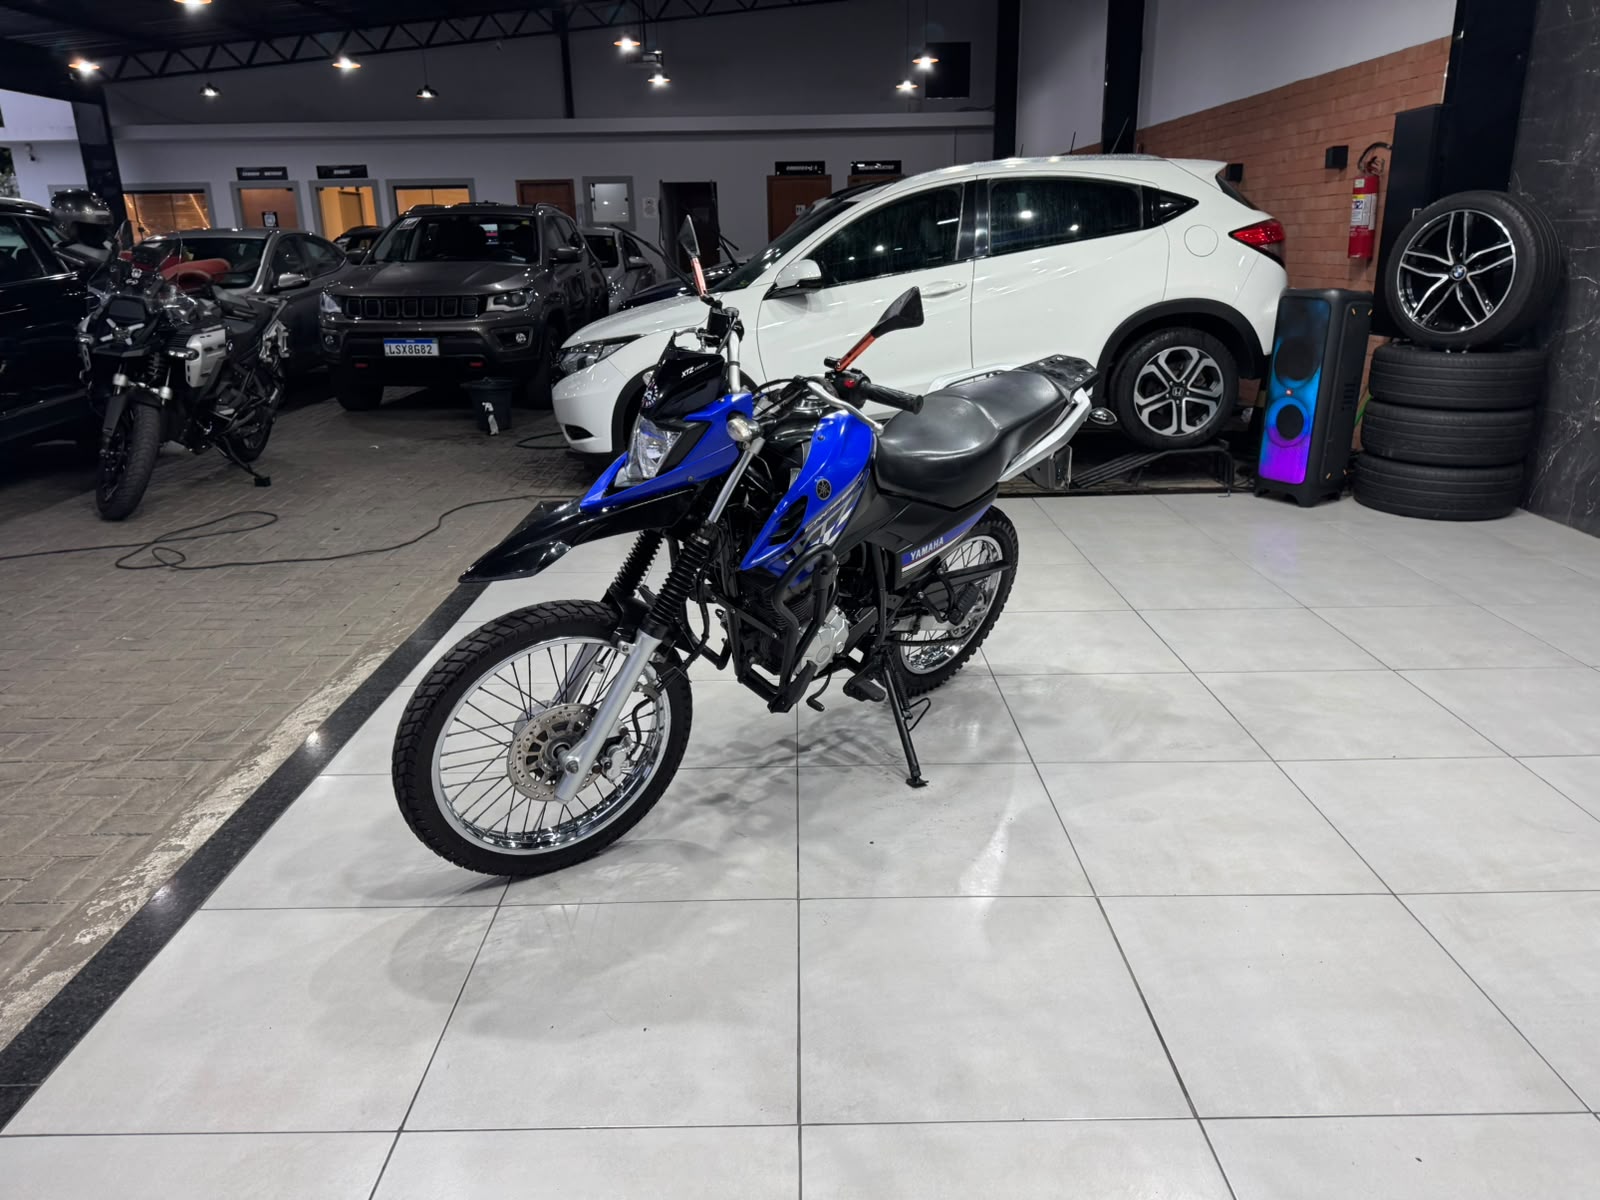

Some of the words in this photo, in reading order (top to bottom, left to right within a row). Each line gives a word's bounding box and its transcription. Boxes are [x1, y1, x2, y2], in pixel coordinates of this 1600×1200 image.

[389, 344, 433, 355] LSX8G82
[681, 366, 695, 378] XTZ
[910, 536, 944, 561] YAMAHA
